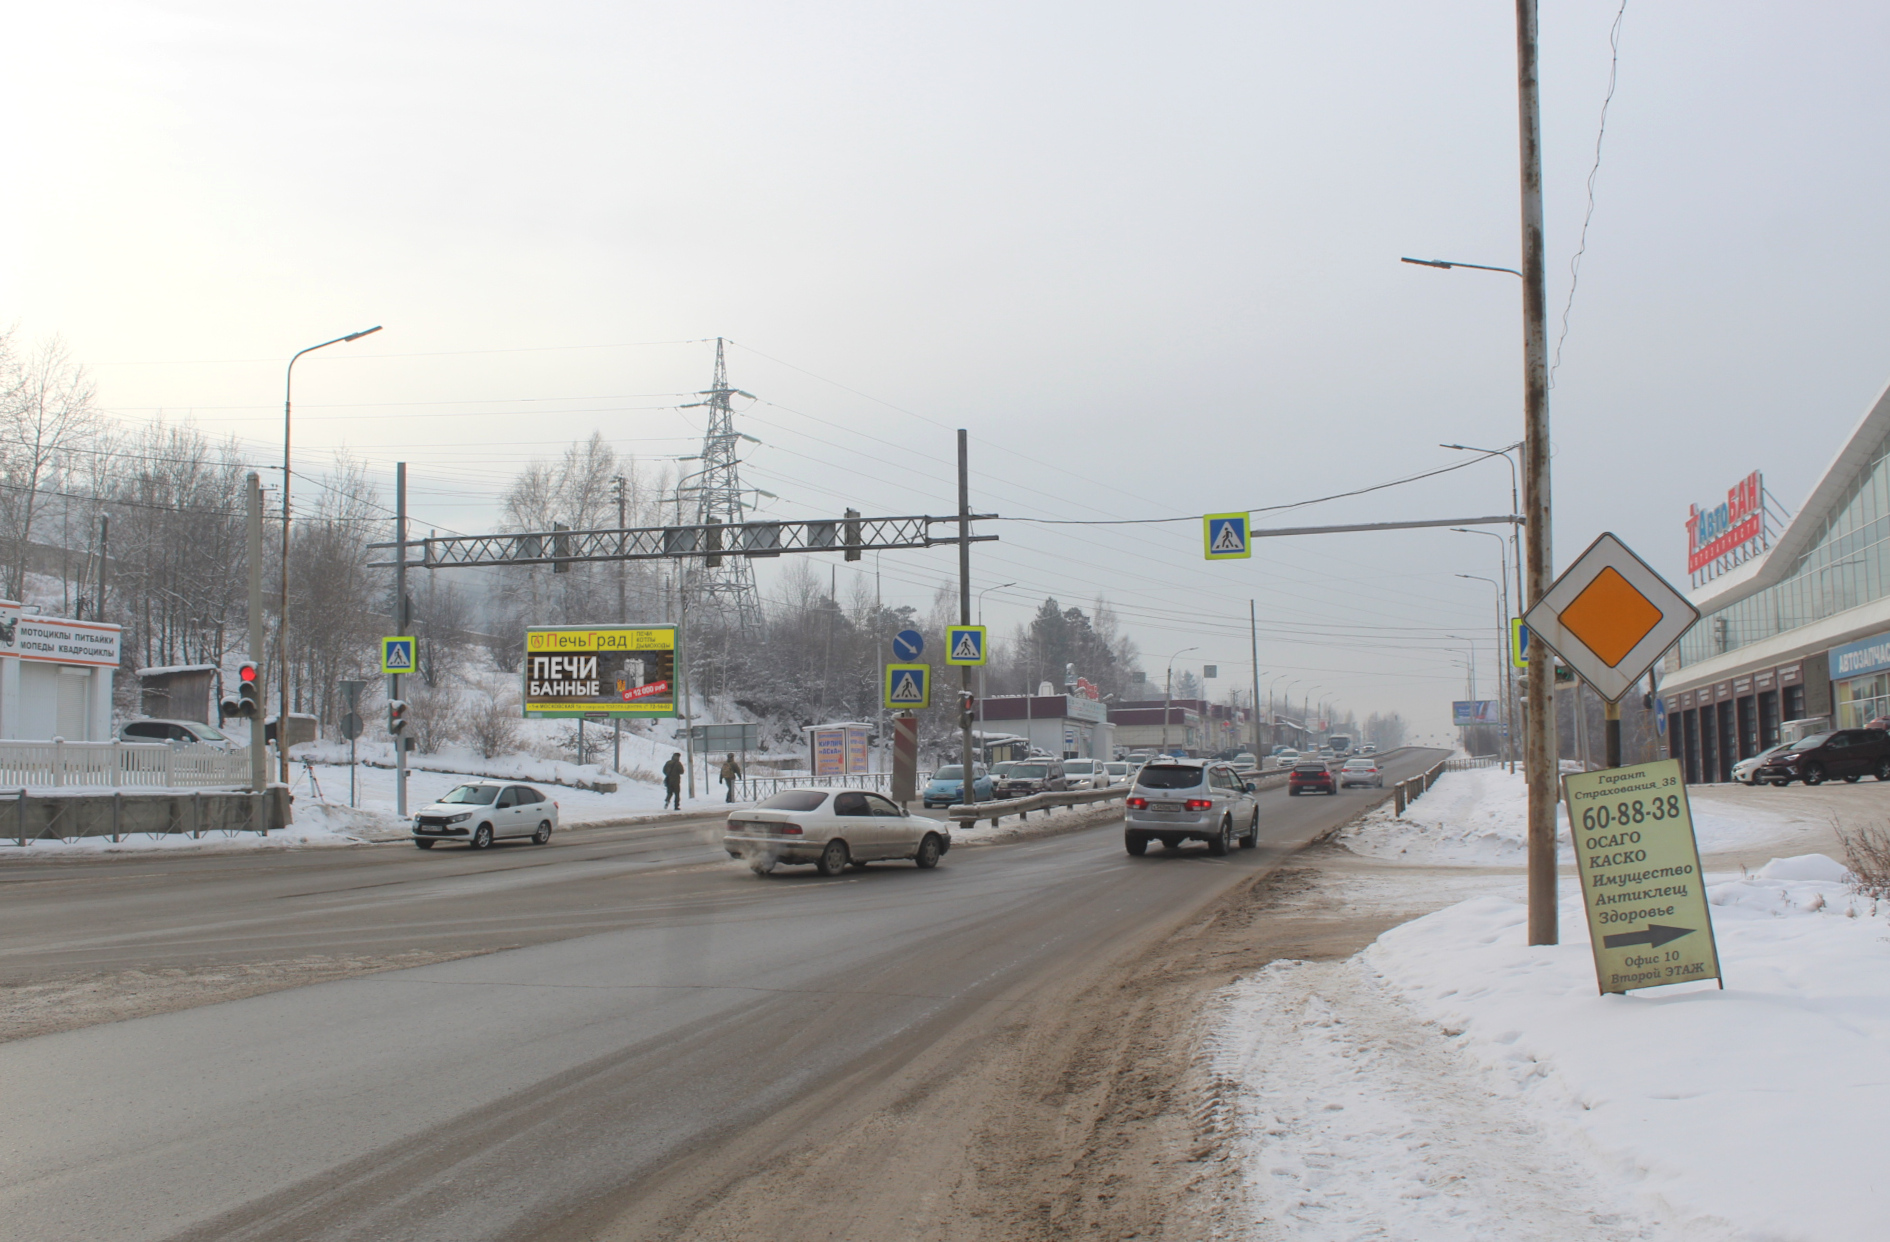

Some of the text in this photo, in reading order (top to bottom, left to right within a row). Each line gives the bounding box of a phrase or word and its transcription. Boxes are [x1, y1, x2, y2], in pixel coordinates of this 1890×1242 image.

[1689, 519, 1758, 569] АВТОЗАПЧАСТИ
[20, 627, 114, 645] МОТОЦИКЛЫ ПИТБАЙКИ
[546, 632, 628, 651] ПечьГрад
[20, 641, 115, 657] МОПЕДЫ КВАДРОЦИКЛЫ
[533, 656, 597, 680] ПЕЧИ
[530, 681, 600, 696] БАННЫЕ
[1598, 771, 1646, 785] Гарант
[1582, 794, 1680, 831] 60-88-38
[1586, 831, 1641, 850] ОСАГО
[1589, 849, 1647, 869] КАСКО
[1592, 864, 1693, 888] Имущество
[1595, 884, 1688, 907] Антиклещ
[1599, 905, 1675, 925] Здоровье
[1624, 950, 1680, 969] Офис 10
[1611, 962, 1705, 985] Второй ЭТАЖ
